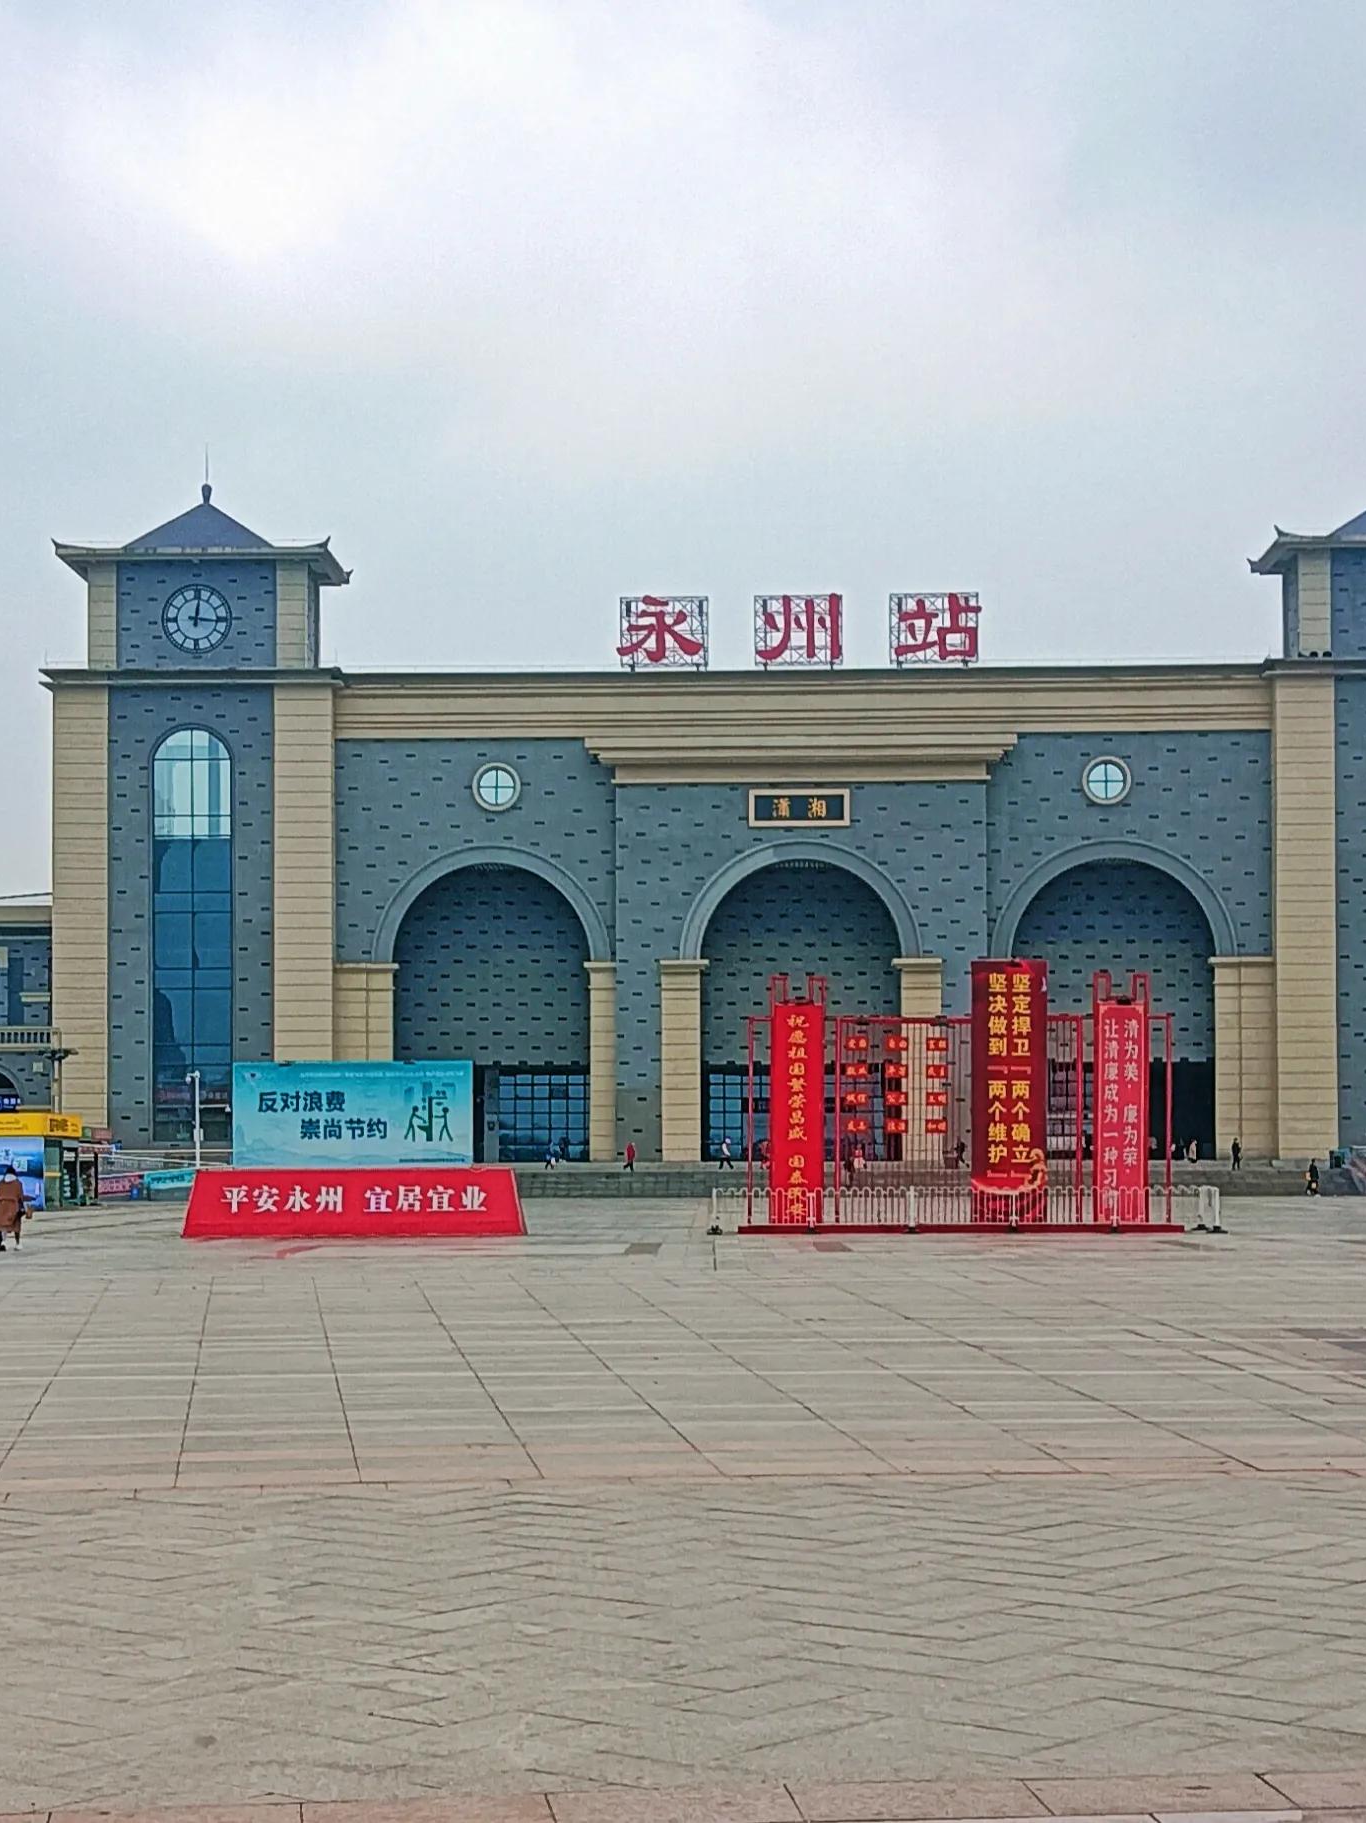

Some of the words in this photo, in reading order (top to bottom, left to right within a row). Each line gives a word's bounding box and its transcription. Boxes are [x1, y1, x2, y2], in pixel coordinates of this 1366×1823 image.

[616, 592, 983, 662] 永州站
[258, 1090, 346, 1113] 反对浪费
[300, 1118, 388, 1140] 崇尚节约
[221, 1185, 344, 1213] 平安永州
[363, 1185, 487, 1213] 宜居宜业
